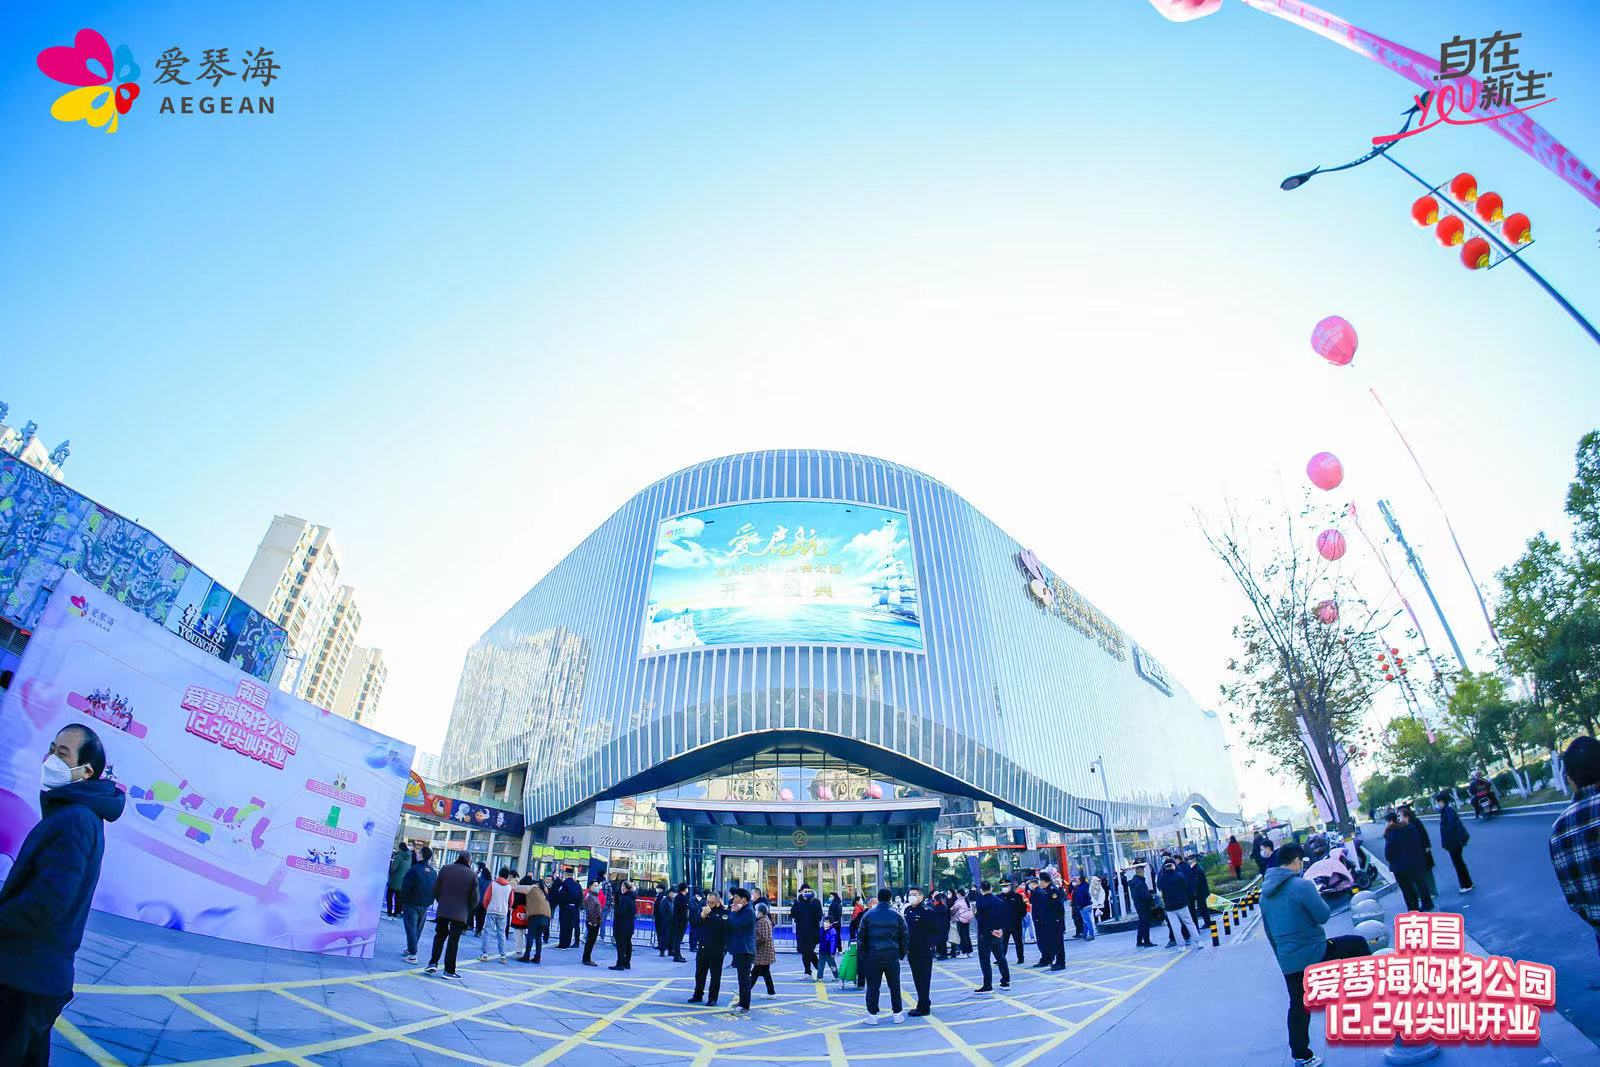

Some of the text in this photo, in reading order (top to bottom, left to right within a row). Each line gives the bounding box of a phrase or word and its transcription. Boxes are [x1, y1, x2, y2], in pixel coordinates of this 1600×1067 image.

[178, 625, 222, 657] YOUNGOR
[182, 603, 228, 644] 雅戈尔
[238, 680, 270, 708] 南昌
[183, 686, 297, 751] 爱琴海购物公园
[188, 710, 287, 766] 12.24尖叫开业
